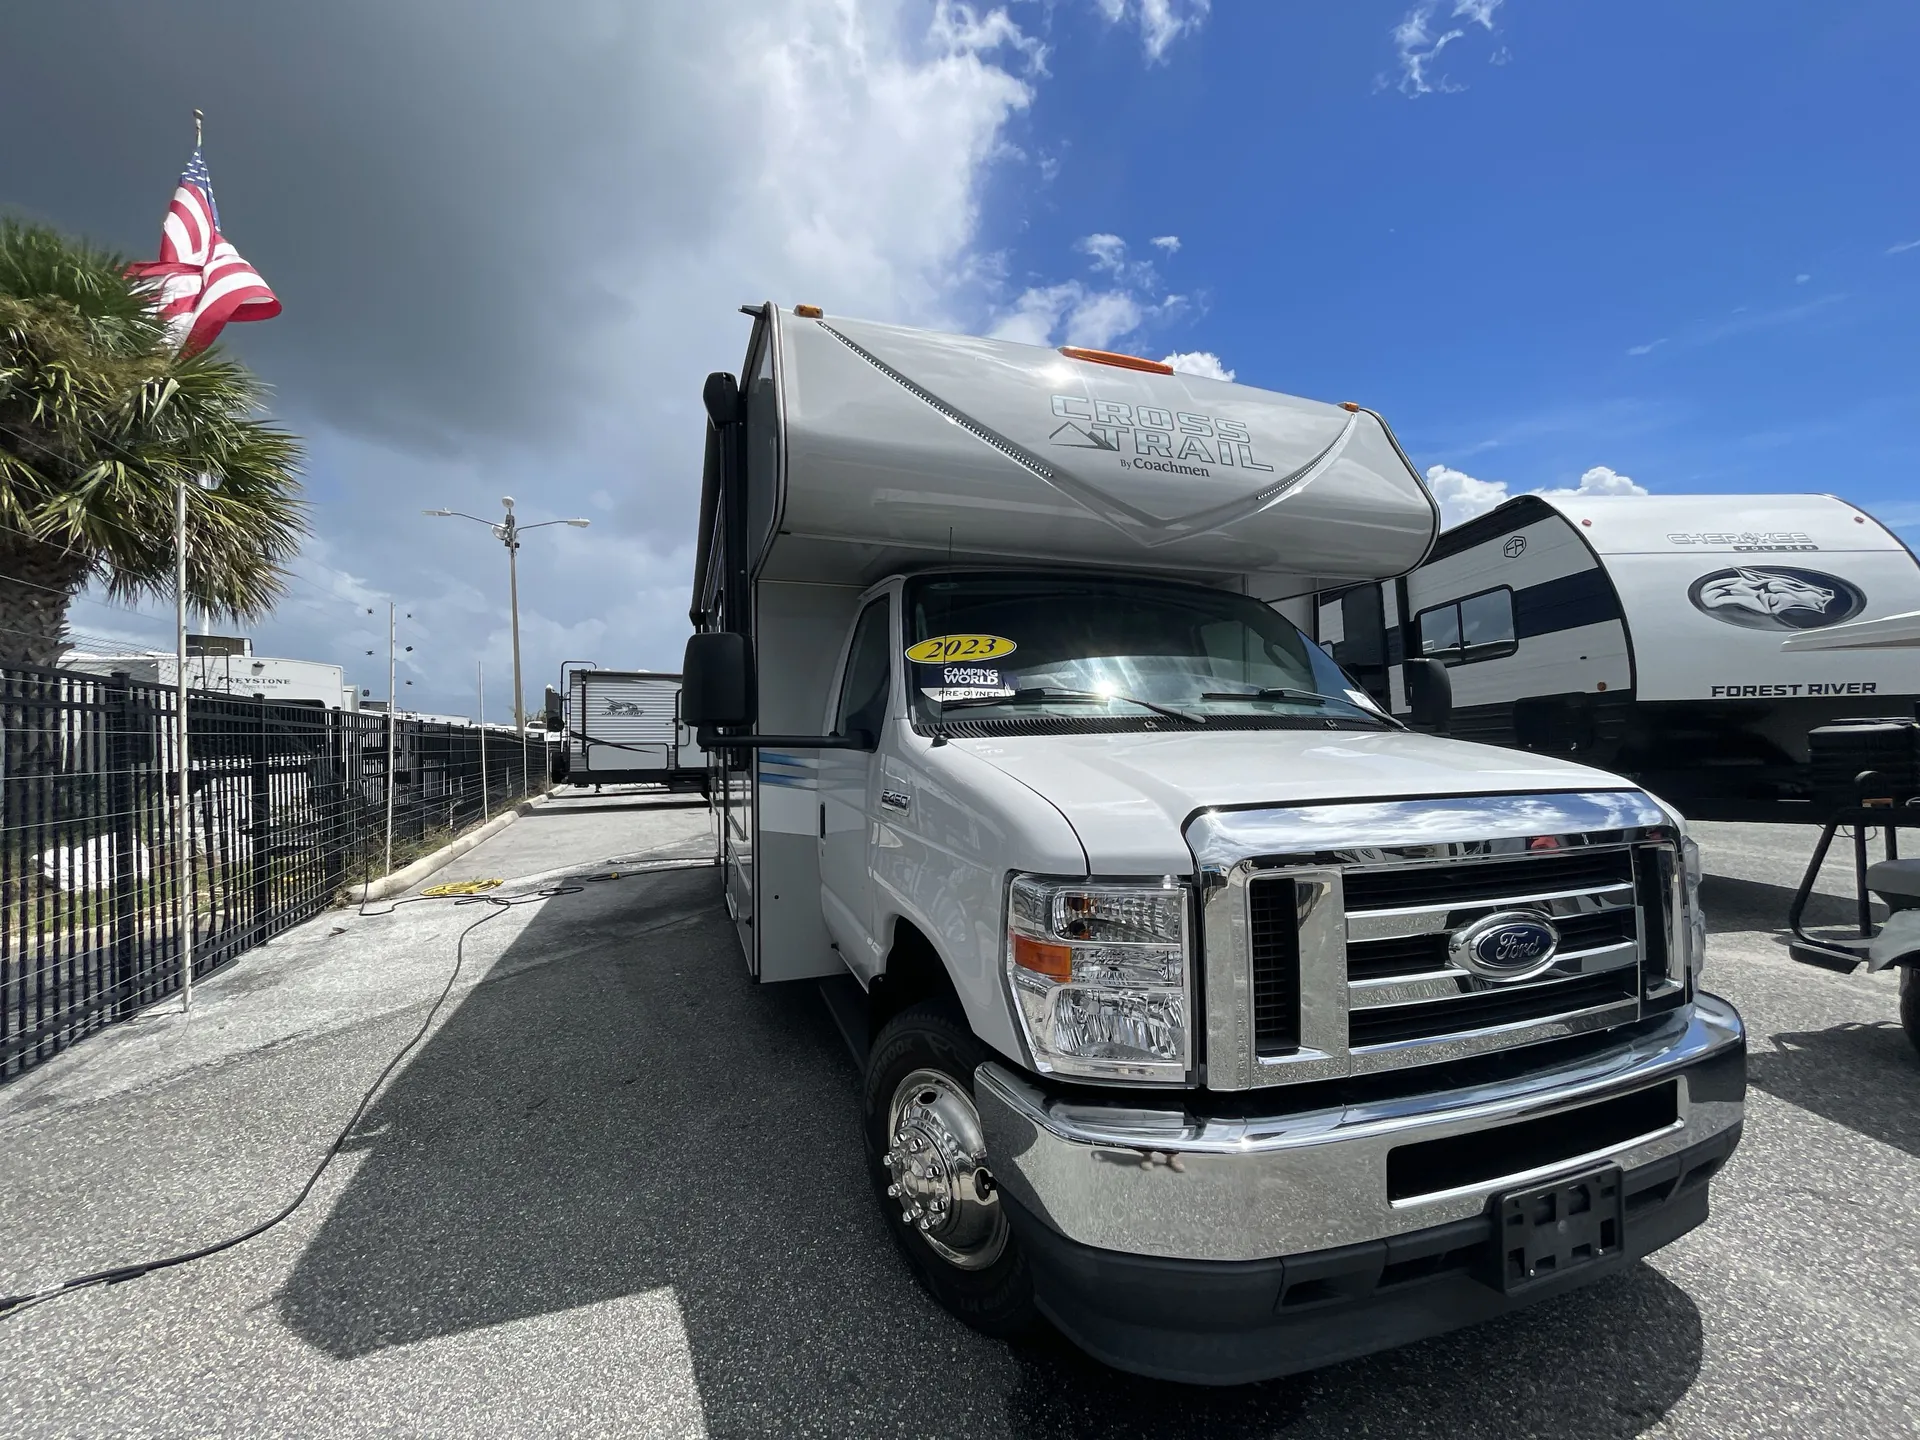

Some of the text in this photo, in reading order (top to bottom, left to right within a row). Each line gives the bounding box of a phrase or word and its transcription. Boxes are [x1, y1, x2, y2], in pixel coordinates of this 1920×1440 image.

[1050, 394, 1251, 444] CROSS
[1091, 422, 1275, 473] TRAIL
[1120, 457, 1210, 478] By Coachmen
[1666, 532, 1813, 545] CHEROKEE
[924, 638, 997, 659] 2023
[227, 677, 291, 685] KEYSTONE
[943, 667, 999, 677] CAMPING
[944, 674, 999, 686] WORLD
[1711, 682, 1877, 697] FOREST RIVER
[1496, 931, 1541, 960] Ford
